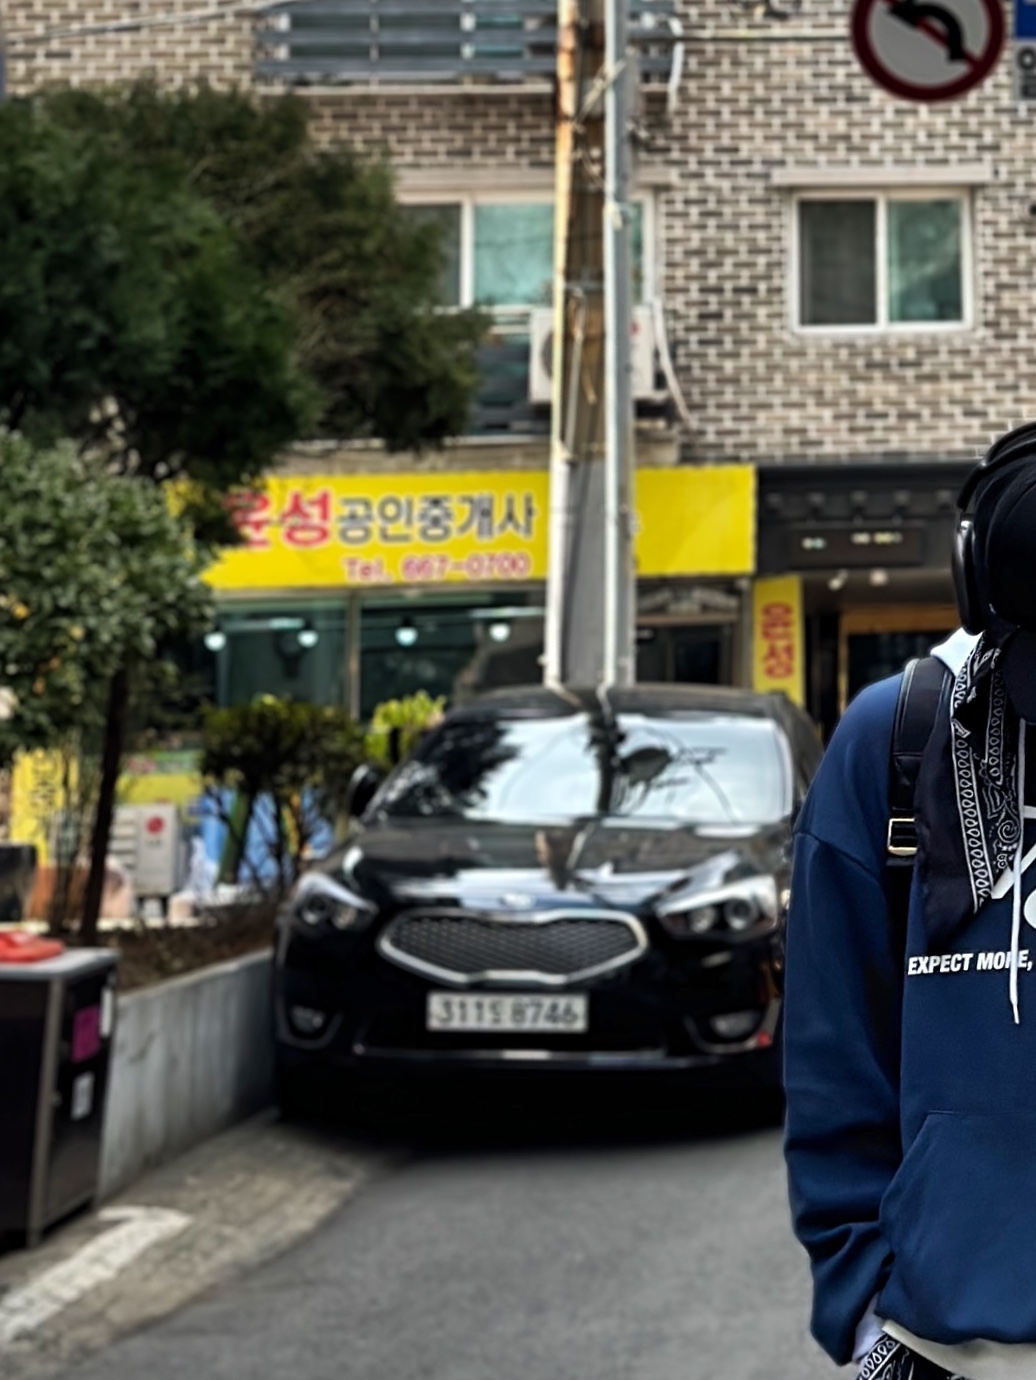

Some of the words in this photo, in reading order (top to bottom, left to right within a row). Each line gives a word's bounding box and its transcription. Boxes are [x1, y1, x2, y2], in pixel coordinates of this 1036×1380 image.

[336, 492, 537, 544] 공인중개사
[344, 557, 391, 582] Tel.
[908, 952, 974, 975] EXPECT
